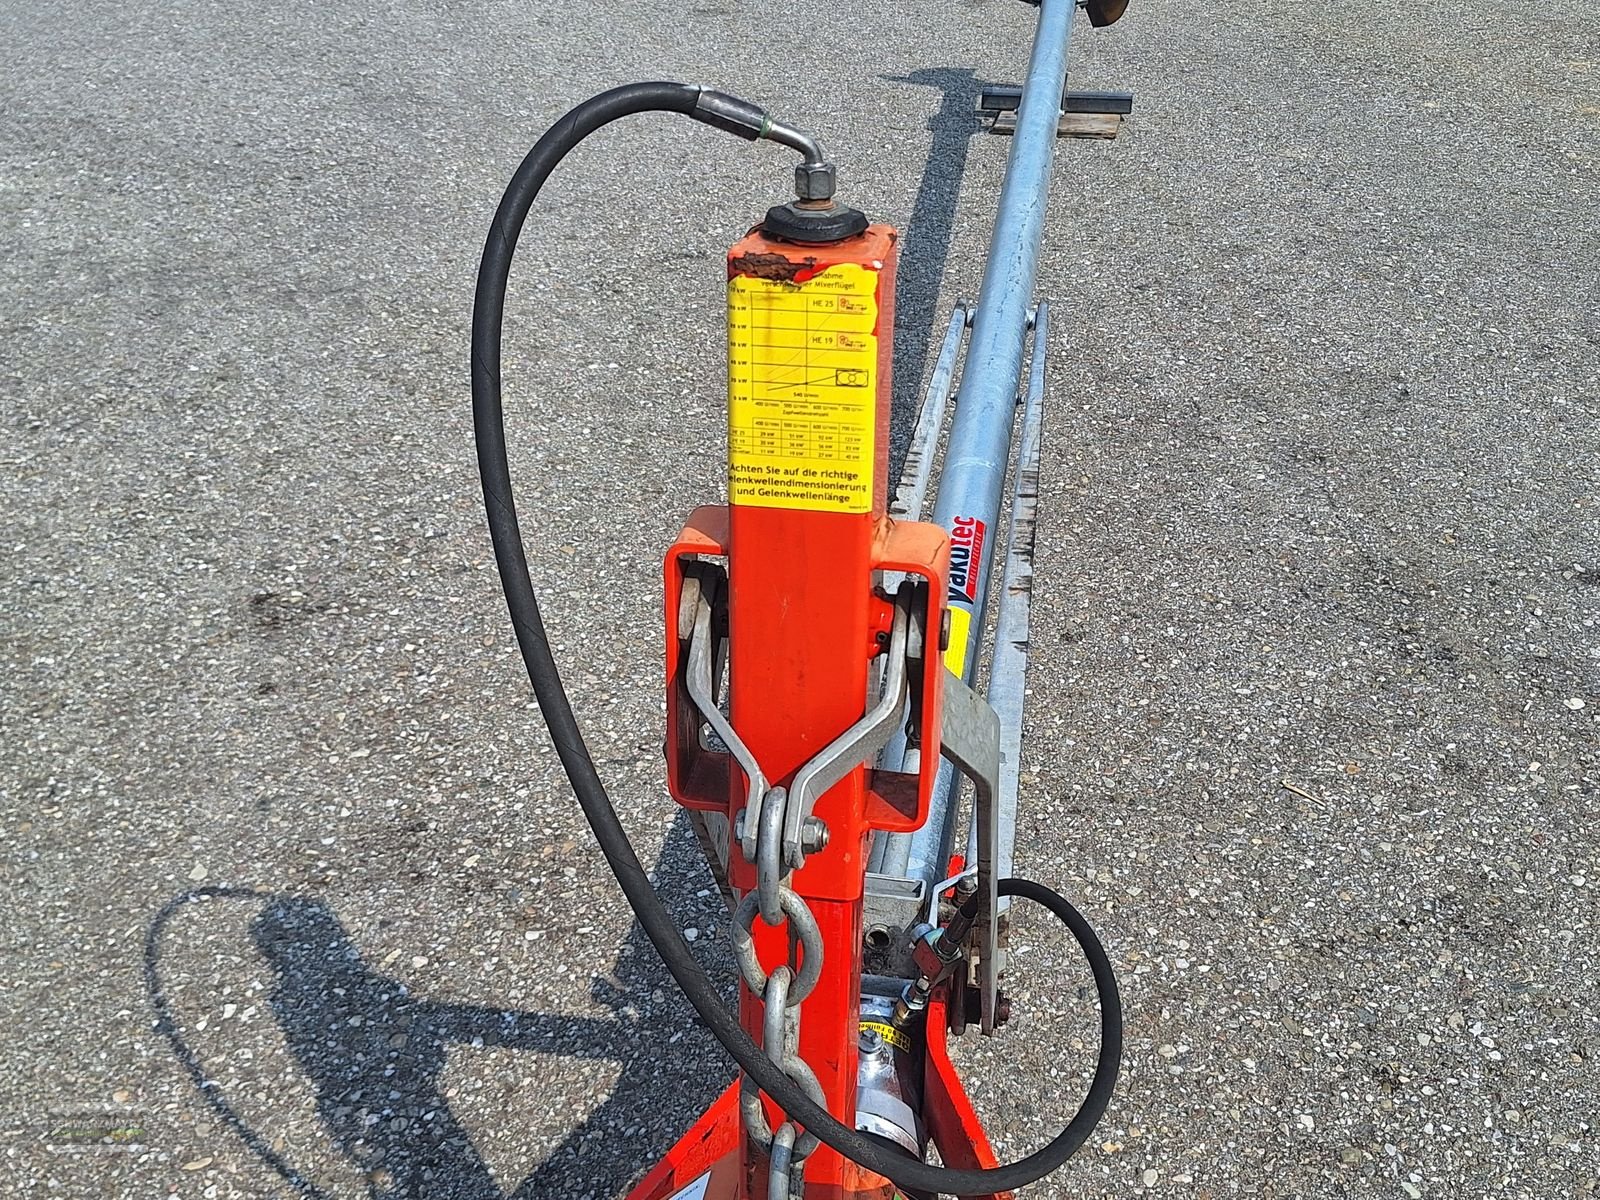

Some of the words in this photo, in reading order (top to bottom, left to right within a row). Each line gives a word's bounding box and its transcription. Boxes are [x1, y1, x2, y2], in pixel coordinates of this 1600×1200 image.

[814, 281, 856, 290] Mixerflügel
[812, 299, 823, 307] HE
[824, 300, 834, 308] 25
[811, 336, 822, 344] HE
[824, 337, 834, 345] 19
[730, 463, 763, 474] Achten
[766, 466, 781, 475] Sie
[784, 467, 800, 477] auf
[802, 469, 818, 478] die
[820, 469, 859, 482] richtige
[728, 475, 867, 493] elenkwellendimensionierung
[737, 487, 755, 496] und
[758, 488, 850, 504] Gelenkwellenlänge
